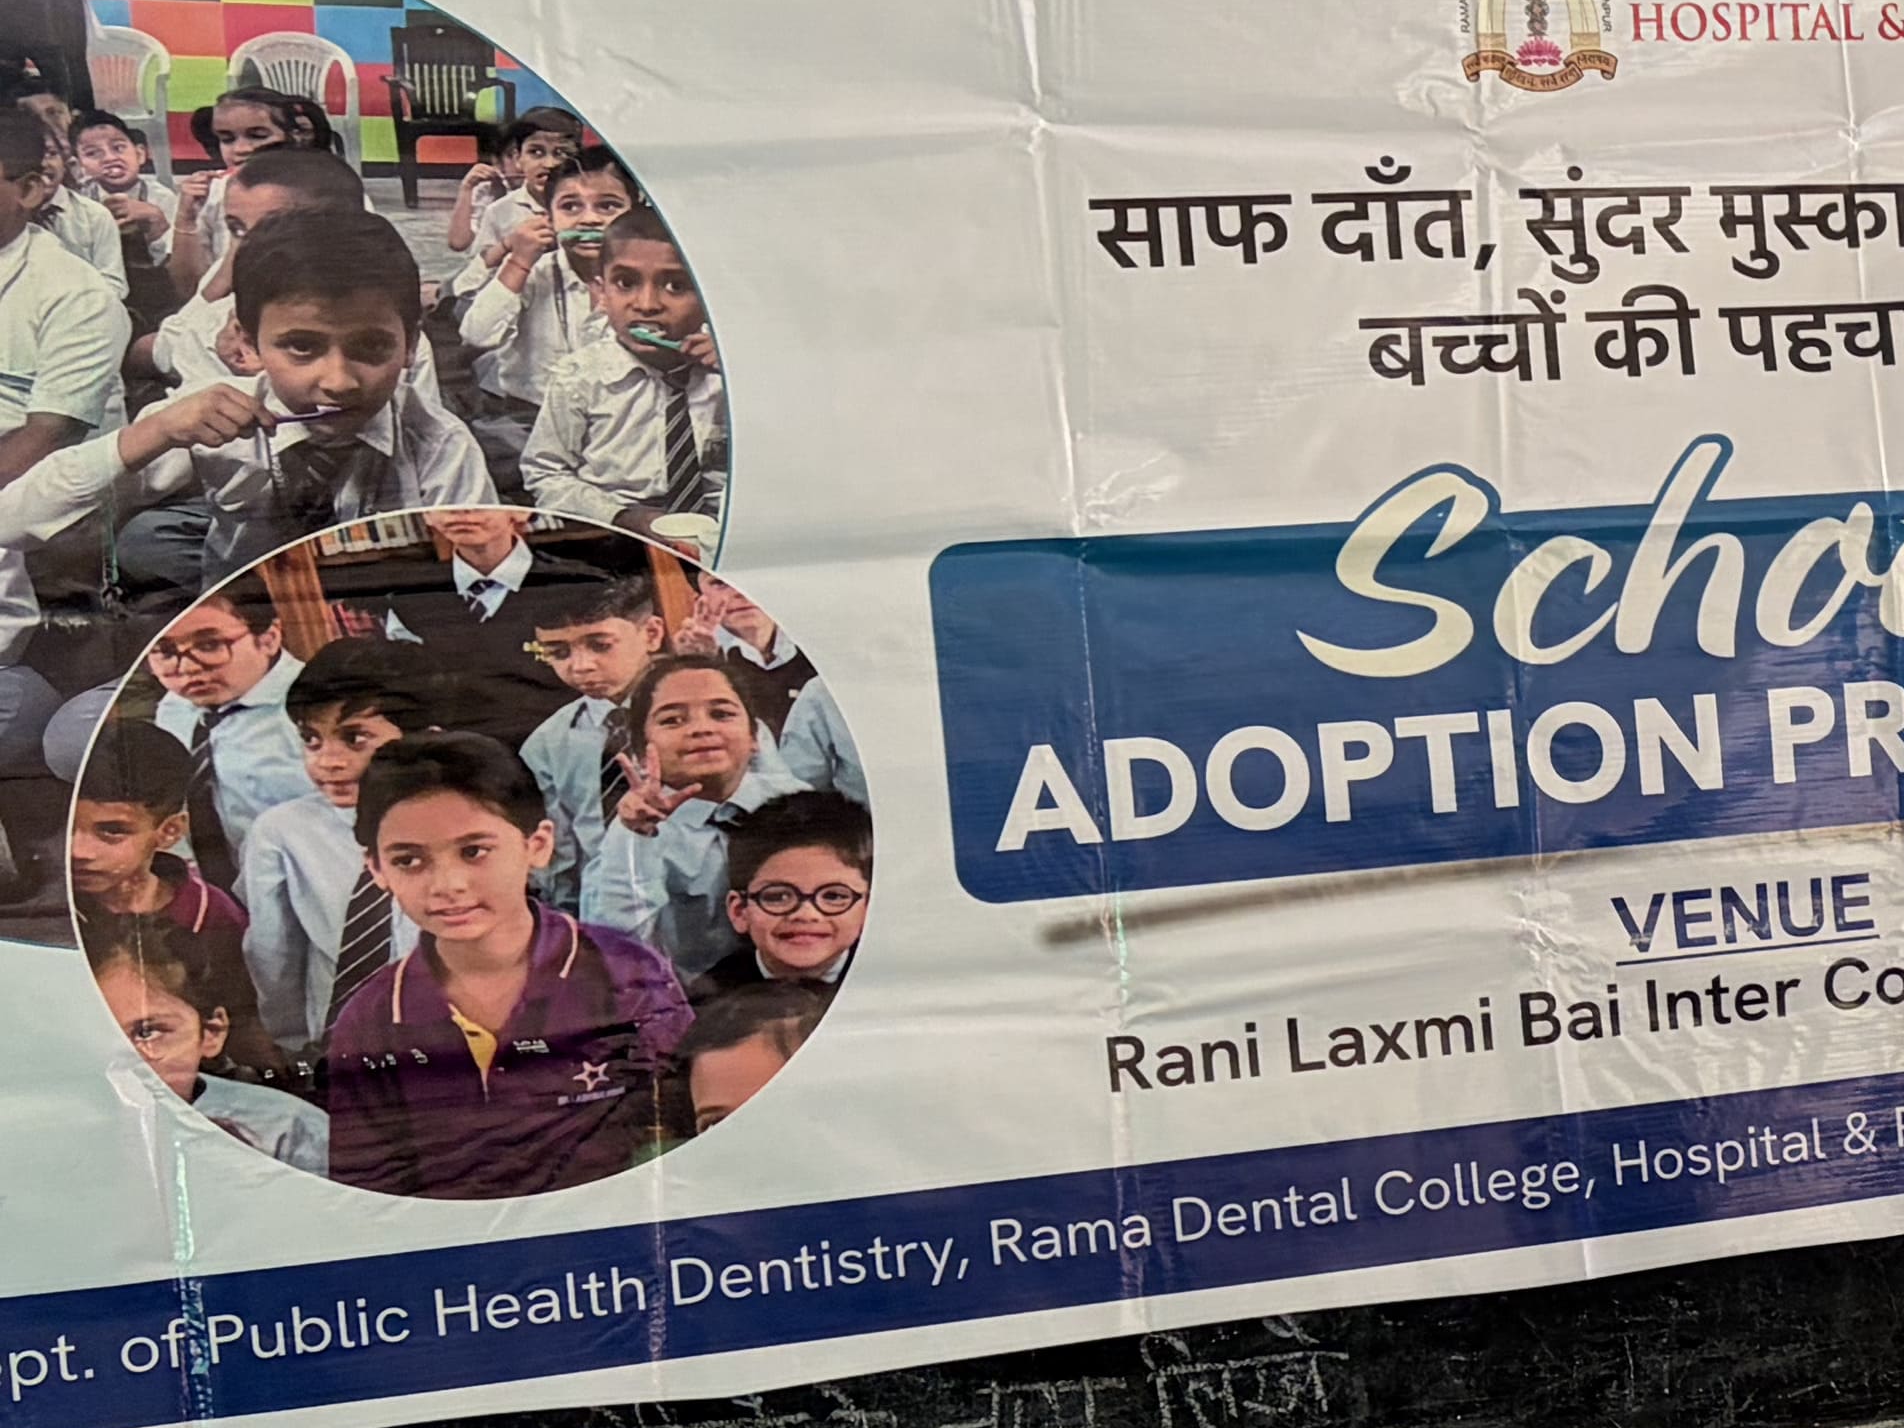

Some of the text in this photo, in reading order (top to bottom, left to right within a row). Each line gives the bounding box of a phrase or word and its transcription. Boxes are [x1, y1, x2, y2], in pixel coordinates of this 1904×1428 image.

[1630, 2, 1864, 42] HOSPITAL
[1088, 193, 1291, 269] साफ
[1312, 155, 1496, 272] दाँत,
[1518, 166, 1691, 284] सुंदर
[1358, 287, 1567, 386] बच्चों
[1585, 286, 1699, 379] की
[995, 693, 1726, 852] ADOPTION
[1611, 873, 1876, 954] VENUE
[1106, 1022, 1261, 1093] Rani
[1287, 997, 1495, 1074] Laxmi
[1520, 983, 1621, 1047] Bai
[1646, 974, 1801, 1033] Inter
[0, 1334, 94, 1403] pt.
[120, 1318, 187, 1373] of
[206, 1298, 411, 1365] Public
[434, 1266, 649, 1337] Health
[669, 1237, 968, 1306] Dentistry,
[989, 1210, 1153, 1267] Rama
[1172, 1177, 1357, 1243] Dental
[1375, 1162, 1596, 1219] College,
[1612, 1118, 1825, 1187] Hospital
[1842, 1111, 1878, 1155] &
